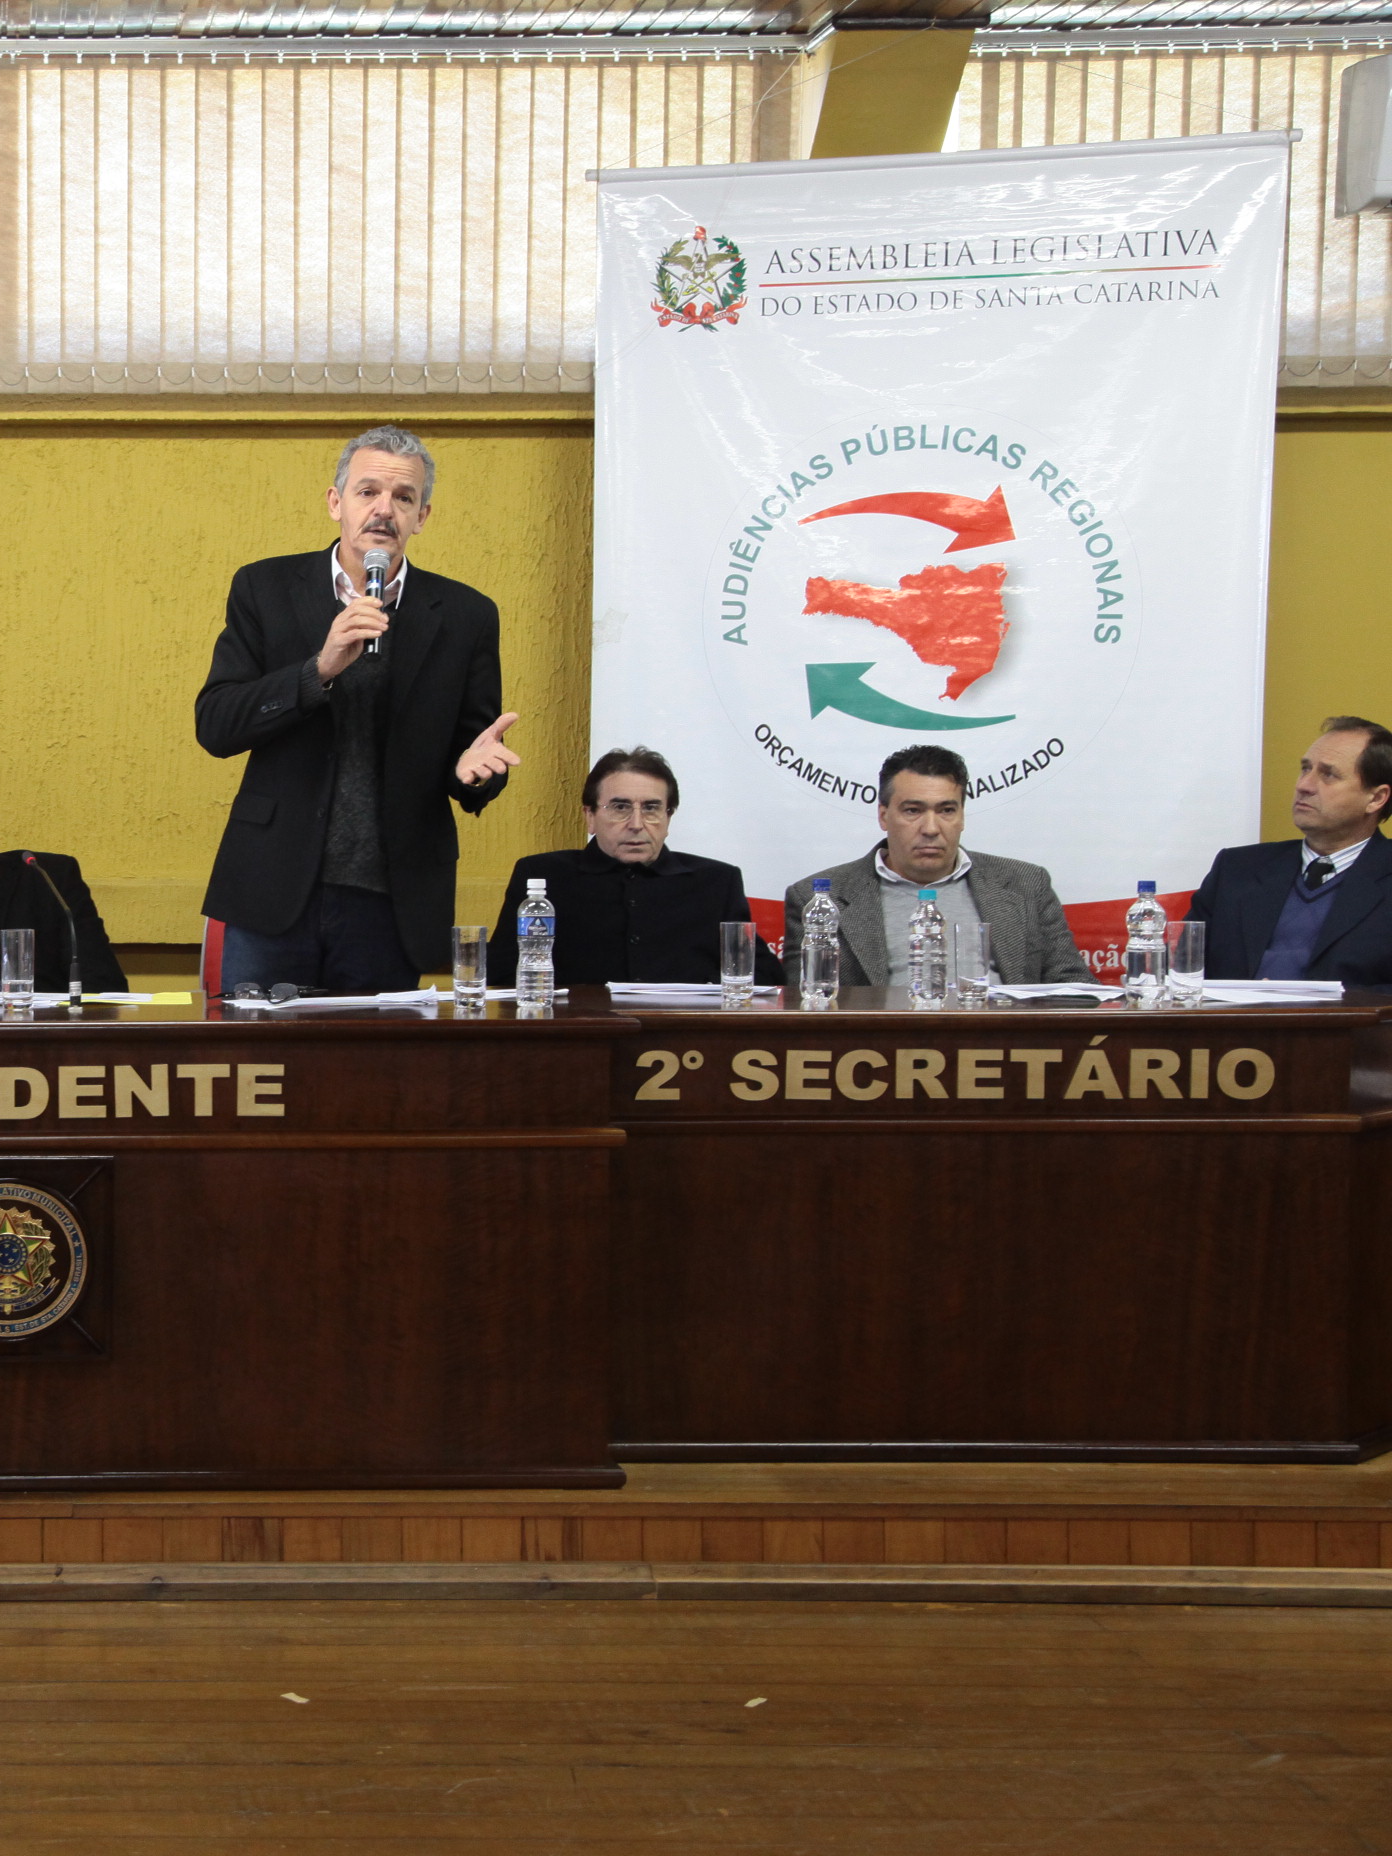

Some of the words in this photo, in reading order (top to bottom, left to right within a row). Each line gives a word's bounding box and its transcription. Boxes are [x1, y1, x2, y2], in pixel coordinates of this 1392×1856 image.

[764, 241, 976, 274] ASSEMBLEIA
[992, 229, 1219, 265] LEGISLATIVA
[760, 296, 802, 317] DO
[813, 291, 918, 315] ESTADO
[930, 290, 964, 311] DE
[974, 285, 1064, 309] SANTA
[1074, 279, 1221, 304] CATARINA
[721, 454, 834, 646] AUDIÊNCIAS
[840, 424, 1026, 470] PÚBLICAS
[1028, 459, 1124, 644] REGIONAIS
[754, 723, 878, 804] ORÇAMENTO
[729, 1034, 1276, 1101] SECRETÁRIO
[31, 1193, 77, 1235] MUNICIPAL
